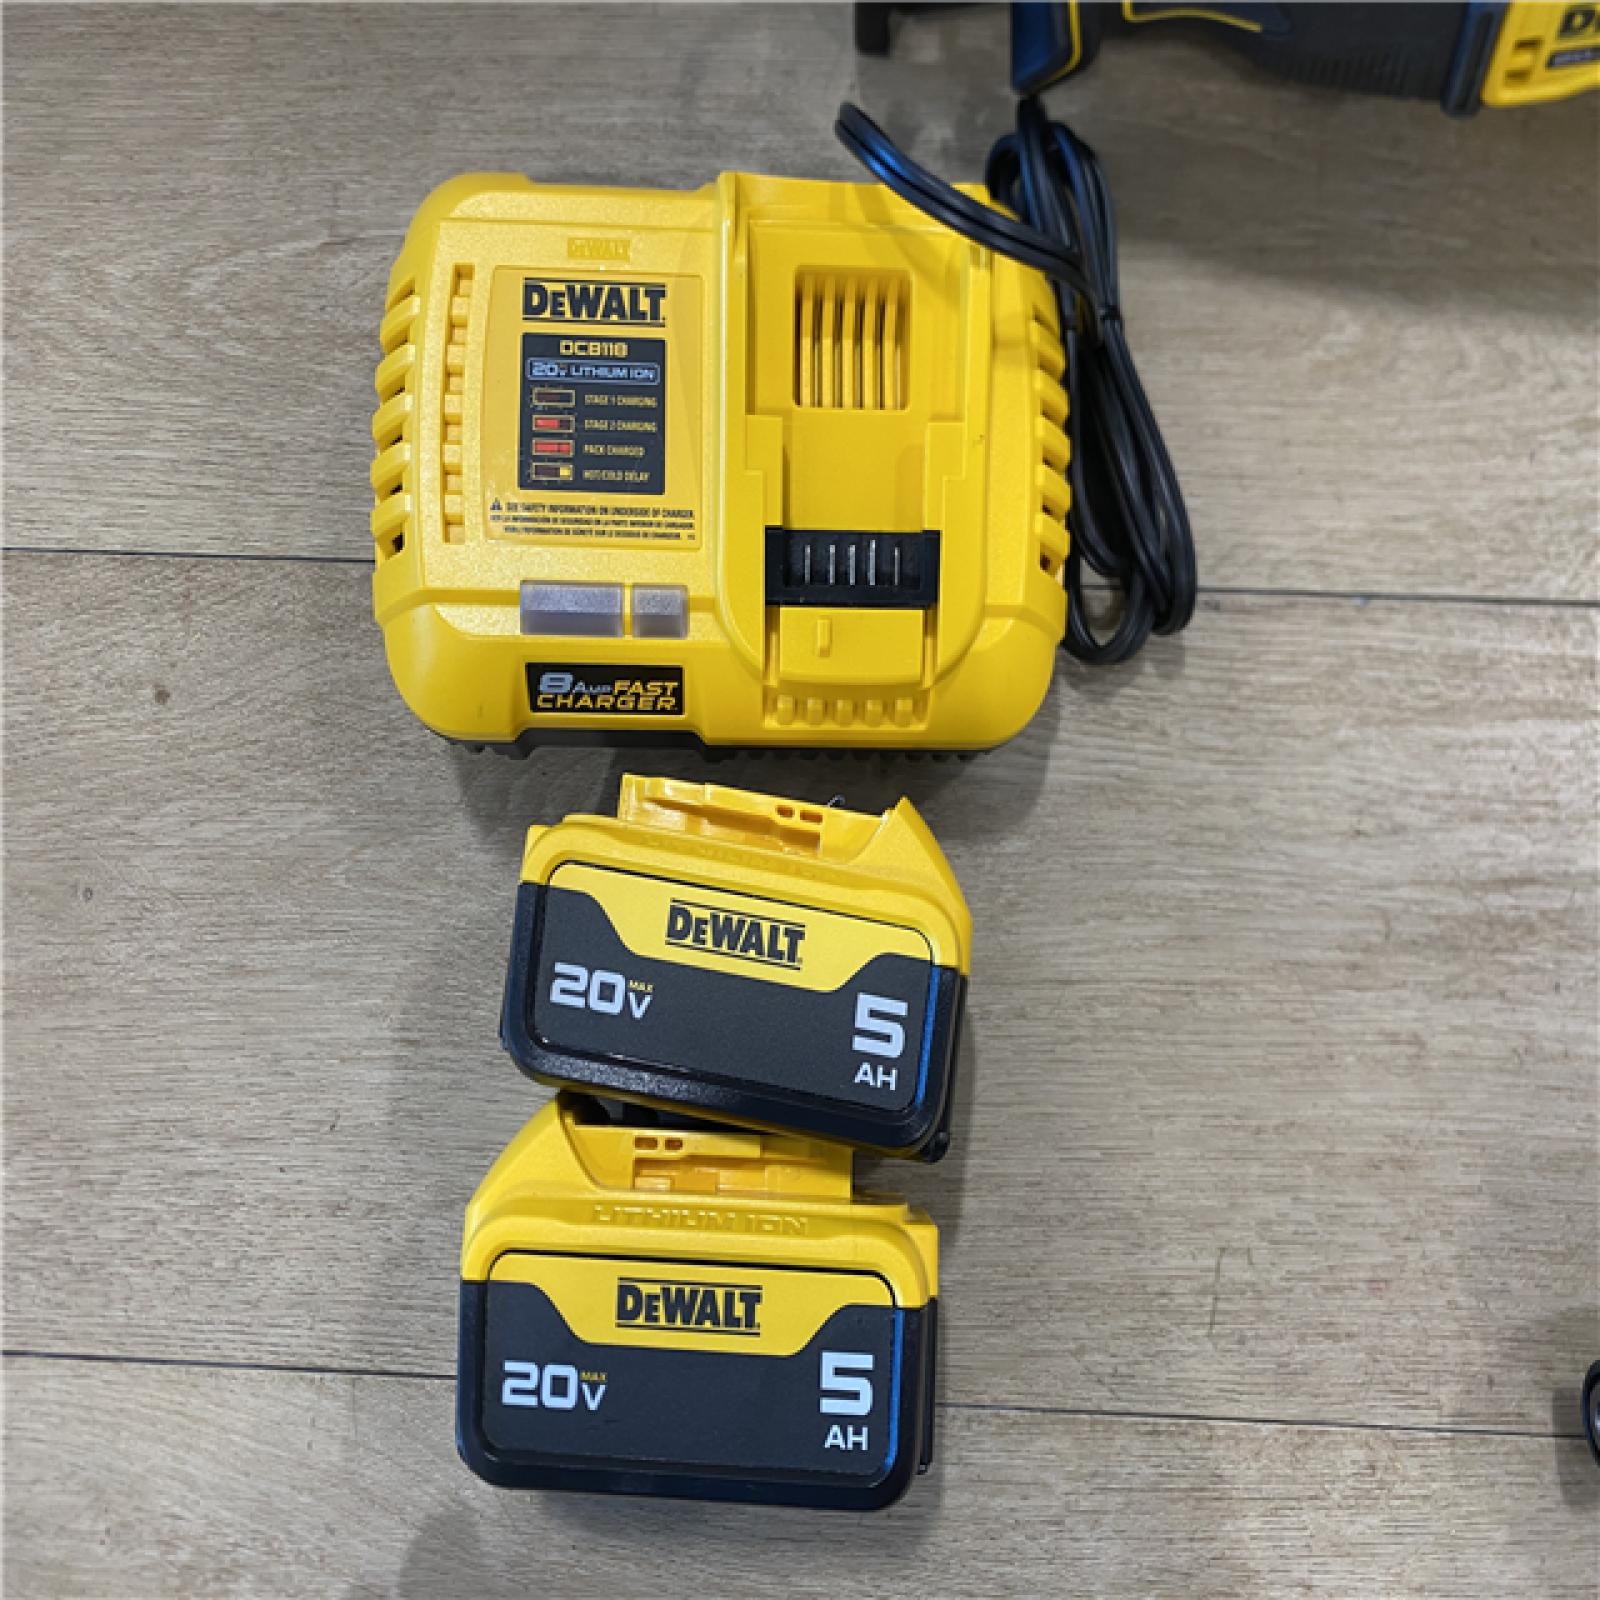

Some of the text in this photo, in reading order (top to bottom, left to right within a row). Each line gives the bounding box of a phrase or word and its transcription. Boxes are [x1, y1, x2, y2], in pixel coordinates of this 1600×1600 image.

[523, 283, 666, 322] DEWALT
[572, 364, 628, 378] LITHIUM
[630, 367, 656, 379] ION
[537, 694, 677, 711] CHARGER
[613, 679, 680, 697] FAST
[666, 901, 805, 966] DEWALT
[852, 992, 908, 1059] 5
[854, 1062, 898, 1091] AH
[594, 1205, 809, 1238] LITHIUM ION
[616, 1283, 761, 1331] DEWALT
[819, 1351, 875, 1417] 5
[824, 1424, 869, 1452] AH
